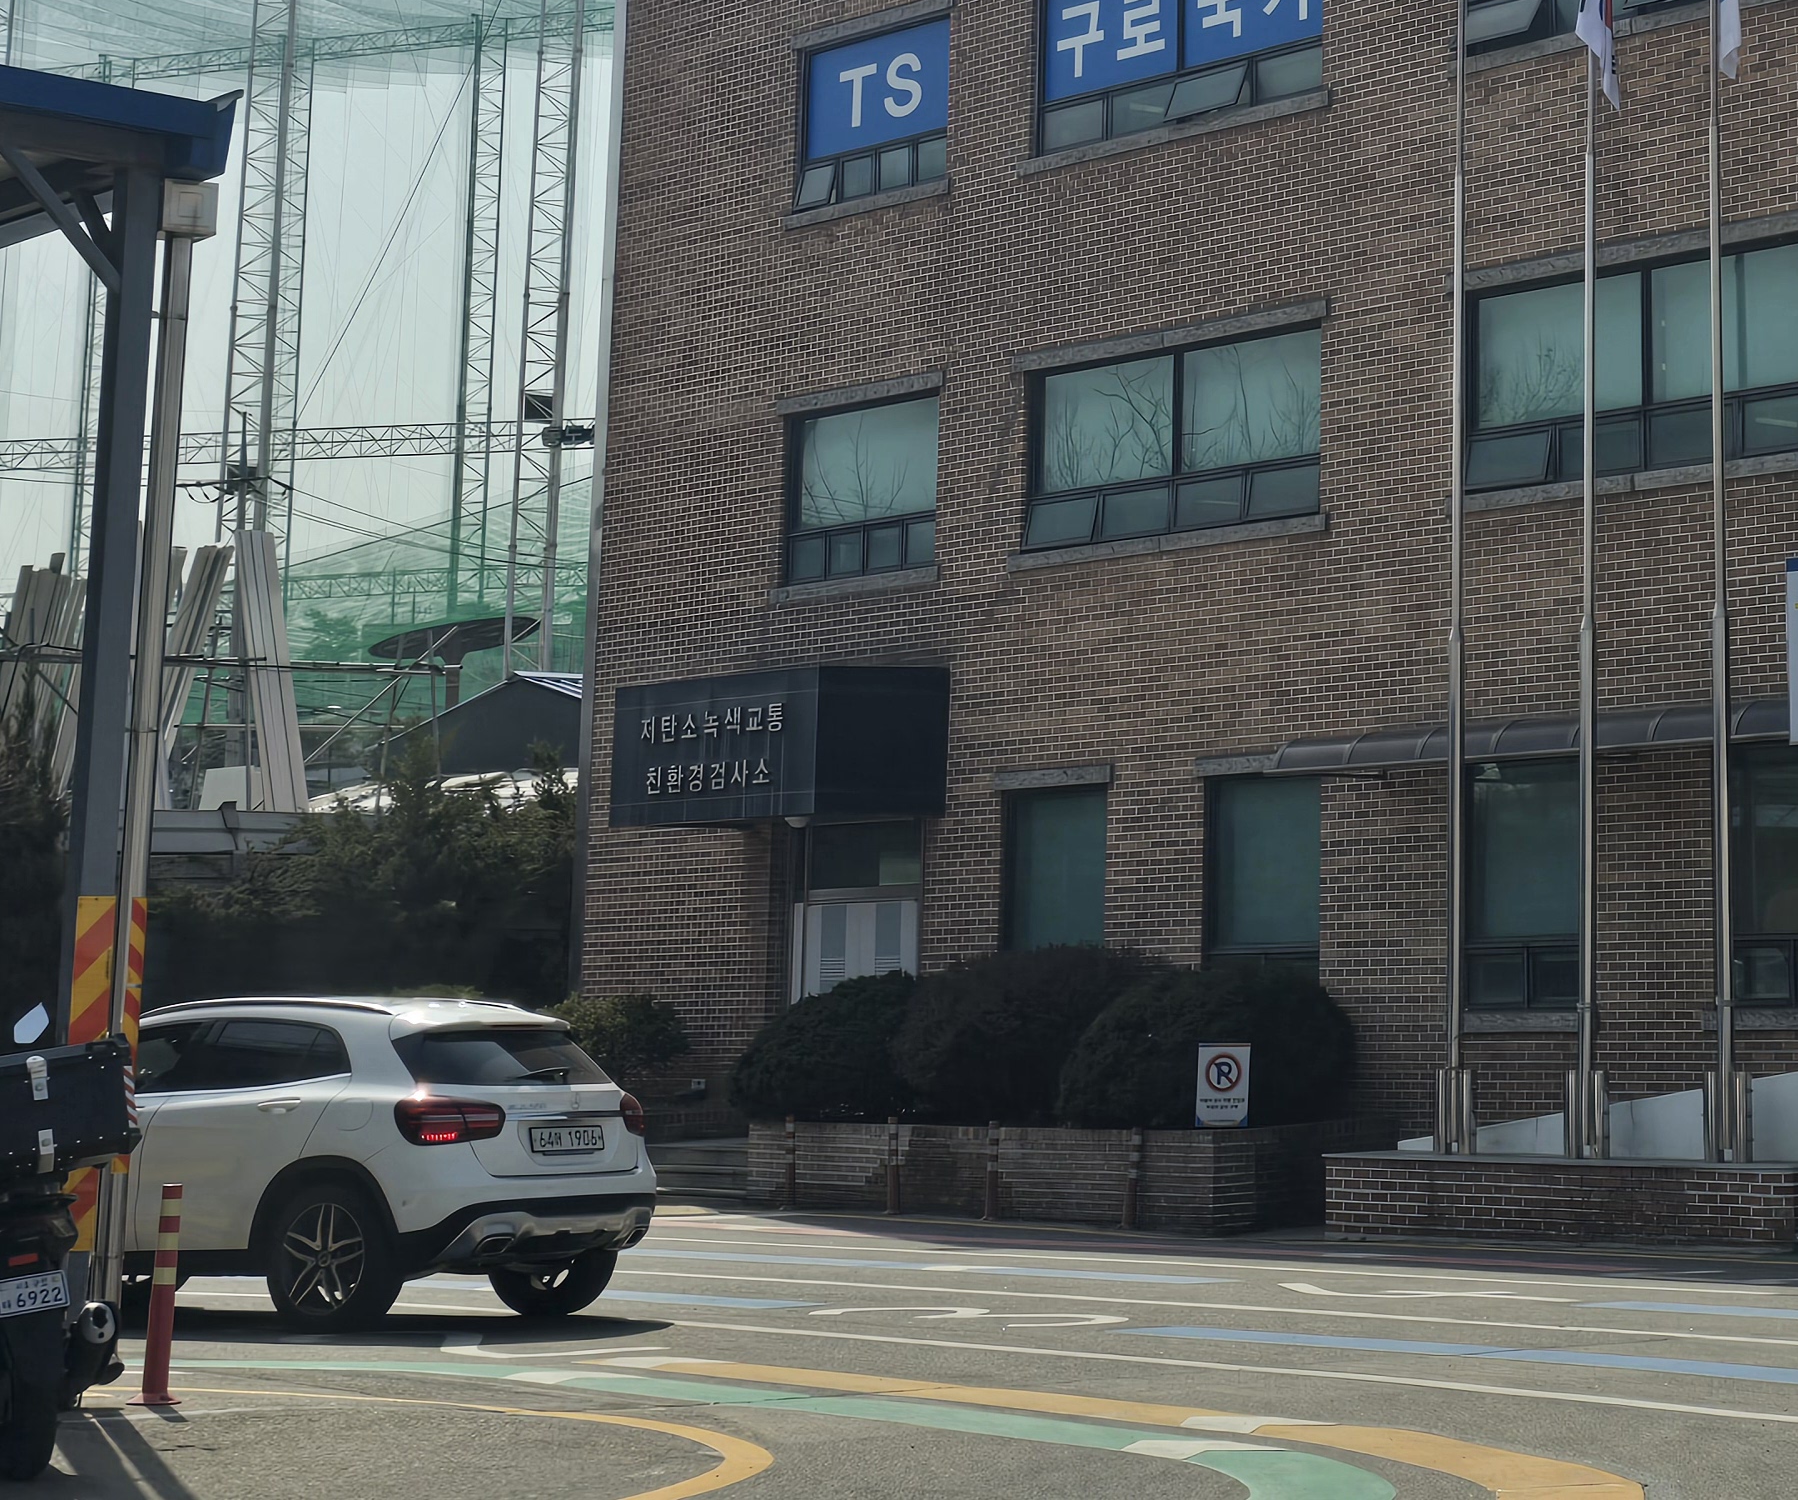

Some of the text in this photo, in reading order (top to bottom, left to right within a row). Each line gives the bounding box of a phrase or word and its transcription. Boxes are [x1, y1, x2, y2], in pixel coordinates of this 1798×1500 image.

[838, 52, 924, 129] TS
[646, 758, 770, 795] 친환경검사소
[568, 1129, 598, 1147] 1906
[17, 1286, 63, 1308] 6922
